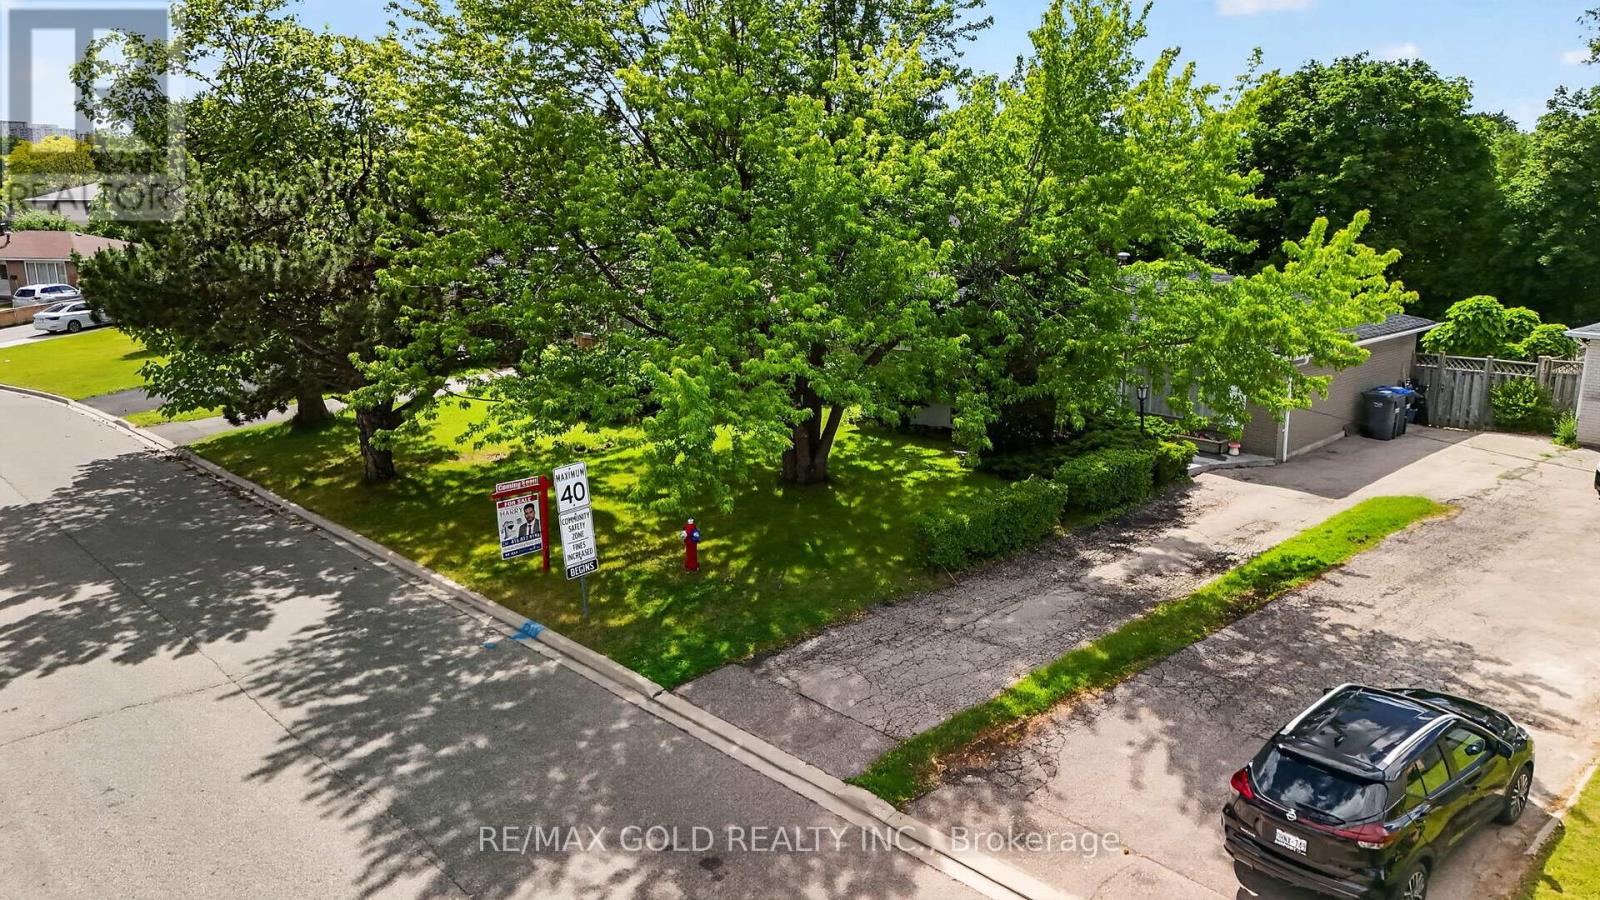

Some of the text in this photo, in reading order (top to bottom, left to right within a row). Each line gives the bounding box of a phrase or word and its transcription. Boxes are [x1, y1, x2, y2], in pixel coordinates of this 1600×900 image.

[556, 469, 585, 482] MAXIMUM
[561, 481, 585, 504] 40
[504, 499, 516, 508] FOR
[561, 512, 590, 526] COMMUNITY
[568, 522, 586, 533] SAFETY
[572, 530, 585, 541] ZONE
[572, 541, 587, 551] FINES
[567, 547, 593, 561] INCREASED
[570, 562, 595, 577] BEGINS
